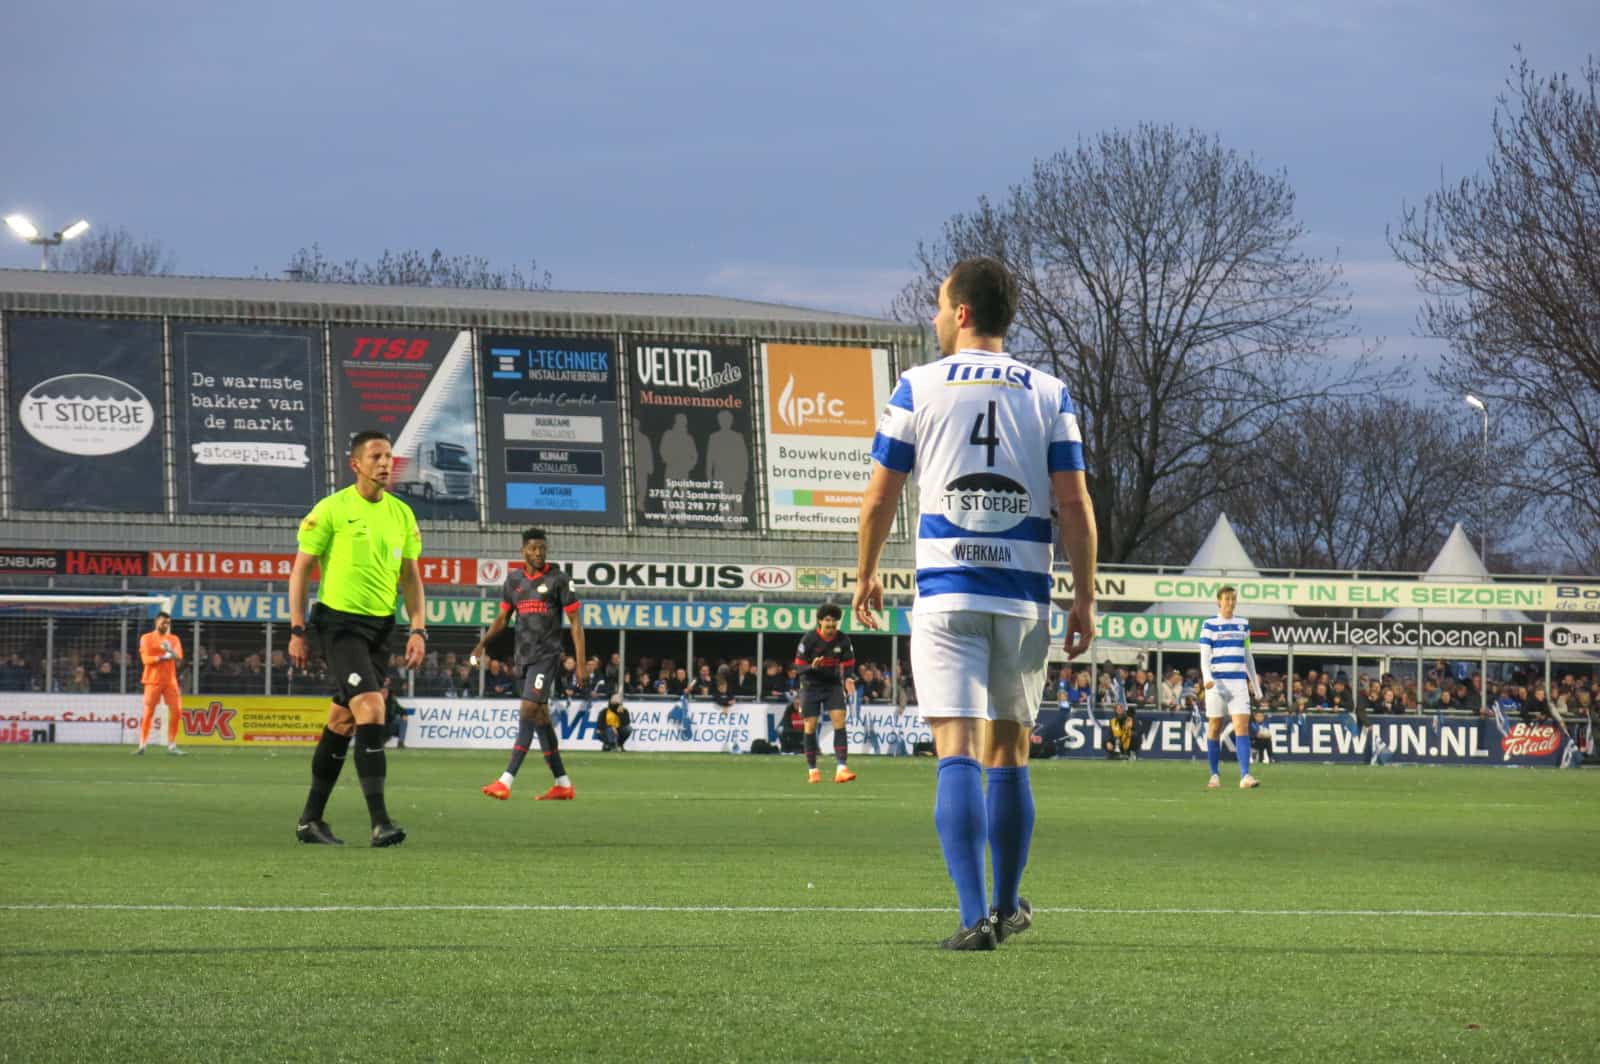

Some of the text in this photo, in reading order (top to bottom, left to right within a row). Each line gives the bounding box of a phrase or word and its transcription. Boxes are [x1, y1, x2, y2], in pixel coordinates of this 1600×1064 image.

[352, 337, 429, 360] TTSB
[528, 349, 608, 371] I-TECHNIEK
[636, 346, 713, 388] VELTEN
[192, 372, 304, 391] De warmste
[192, 395, 305, 412] bakker van
[639, 391, 743, 408] Mannenmode
[55, 402, 145, 425] STOEPJE
[797, 392, 845, 428] pfc
[204, 414, 294, 431] de markt
[970, 400, 999, 468] 4
[203, 444, 297, 463] stoepje.nl
[779, 446, 872, 465] Bouwkundig
[960, 495, 1029, 514] STOEPJE
[955, 543, 1013, 562] WERKMAN
[65, 550, 143, 575] HAPAM
[151, 552, 463, 585] Millenaa rij
[757, 571, 784, 584] KIA
[1154, 581, 1543, 606] COMORT IN ELK SEIZOEN!
[563, 603, 723, 629] RWELIUS
[1107, 615, 1200, 640] BOUW
[1271, 621, 1522, 649] www.HeekSchoenen.nl
[534, 673, 545, 690] 6
[419, 708, 520, 722] VAN HALTER
[631, 712, 661, 724] VAN
[419, 724, 520, 739] TECHNOLOG
[1513, 722, 1555, 737] Bike
[1504, 734, 1556, 761] Totaal
